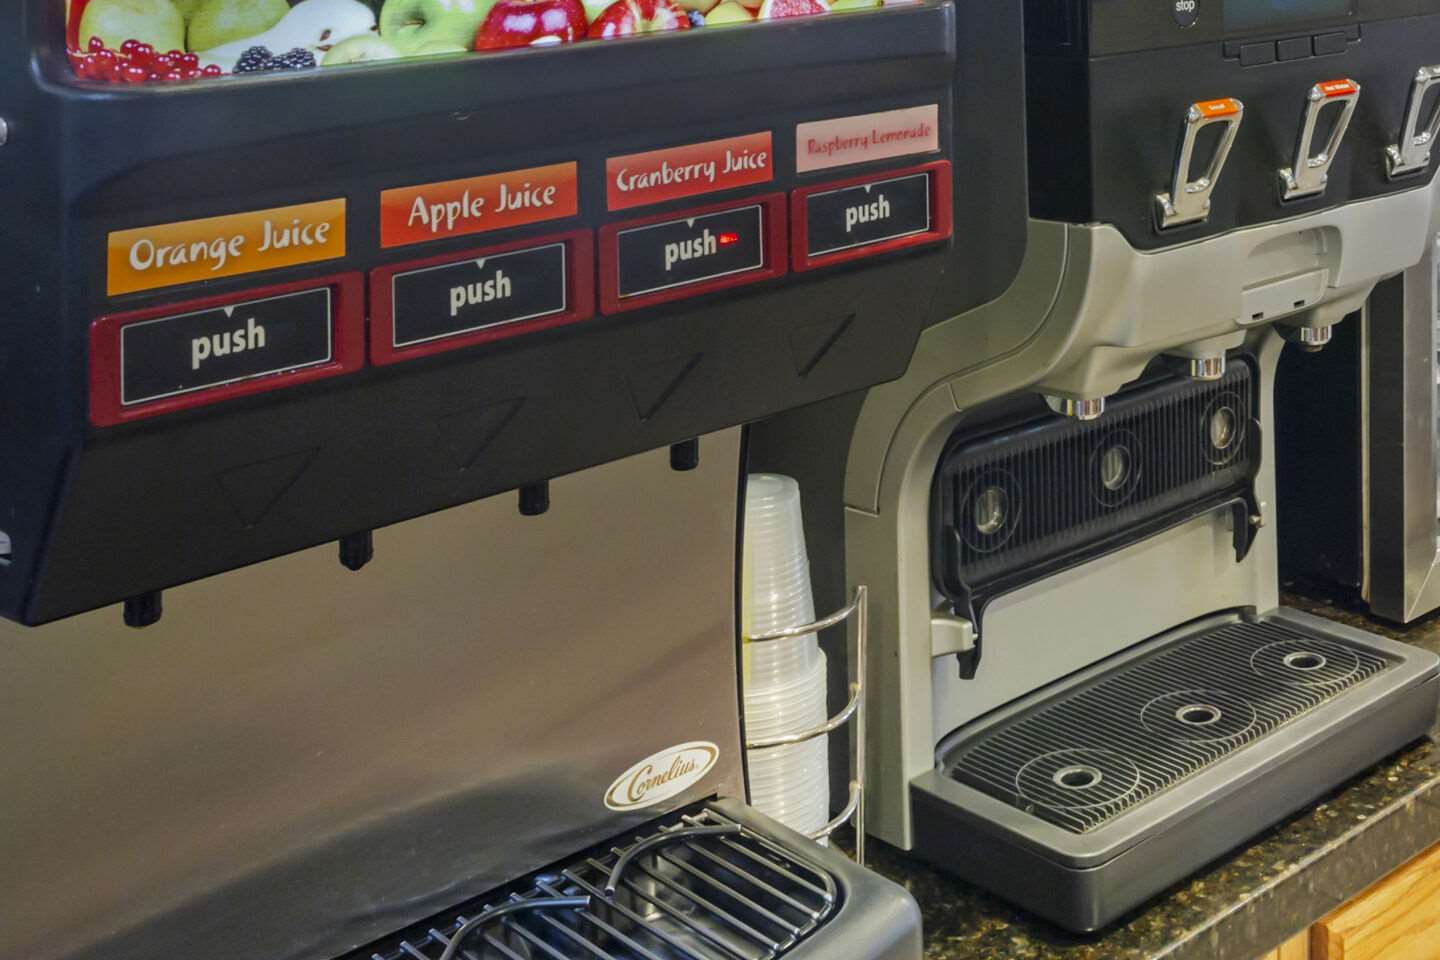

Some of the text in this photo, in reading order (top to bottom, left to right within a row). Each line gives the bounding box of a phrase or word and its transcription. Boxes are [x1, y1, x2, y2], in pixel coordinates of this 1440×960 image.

[1175, 0, 1196, 13] stop
[807, 122, 931, 157] Raspberry Lemonade
[615, 149, 768, 192] Cranberry Juice
[407, 182, 557, 234] Apple Juice
[845, 194, 891, 233] push
[128, 219, 332, 272] Orange Juice
[665, 228, 717, 272] push
[450, 269, 512, 317] push
[191, 317, 267, 370] push
